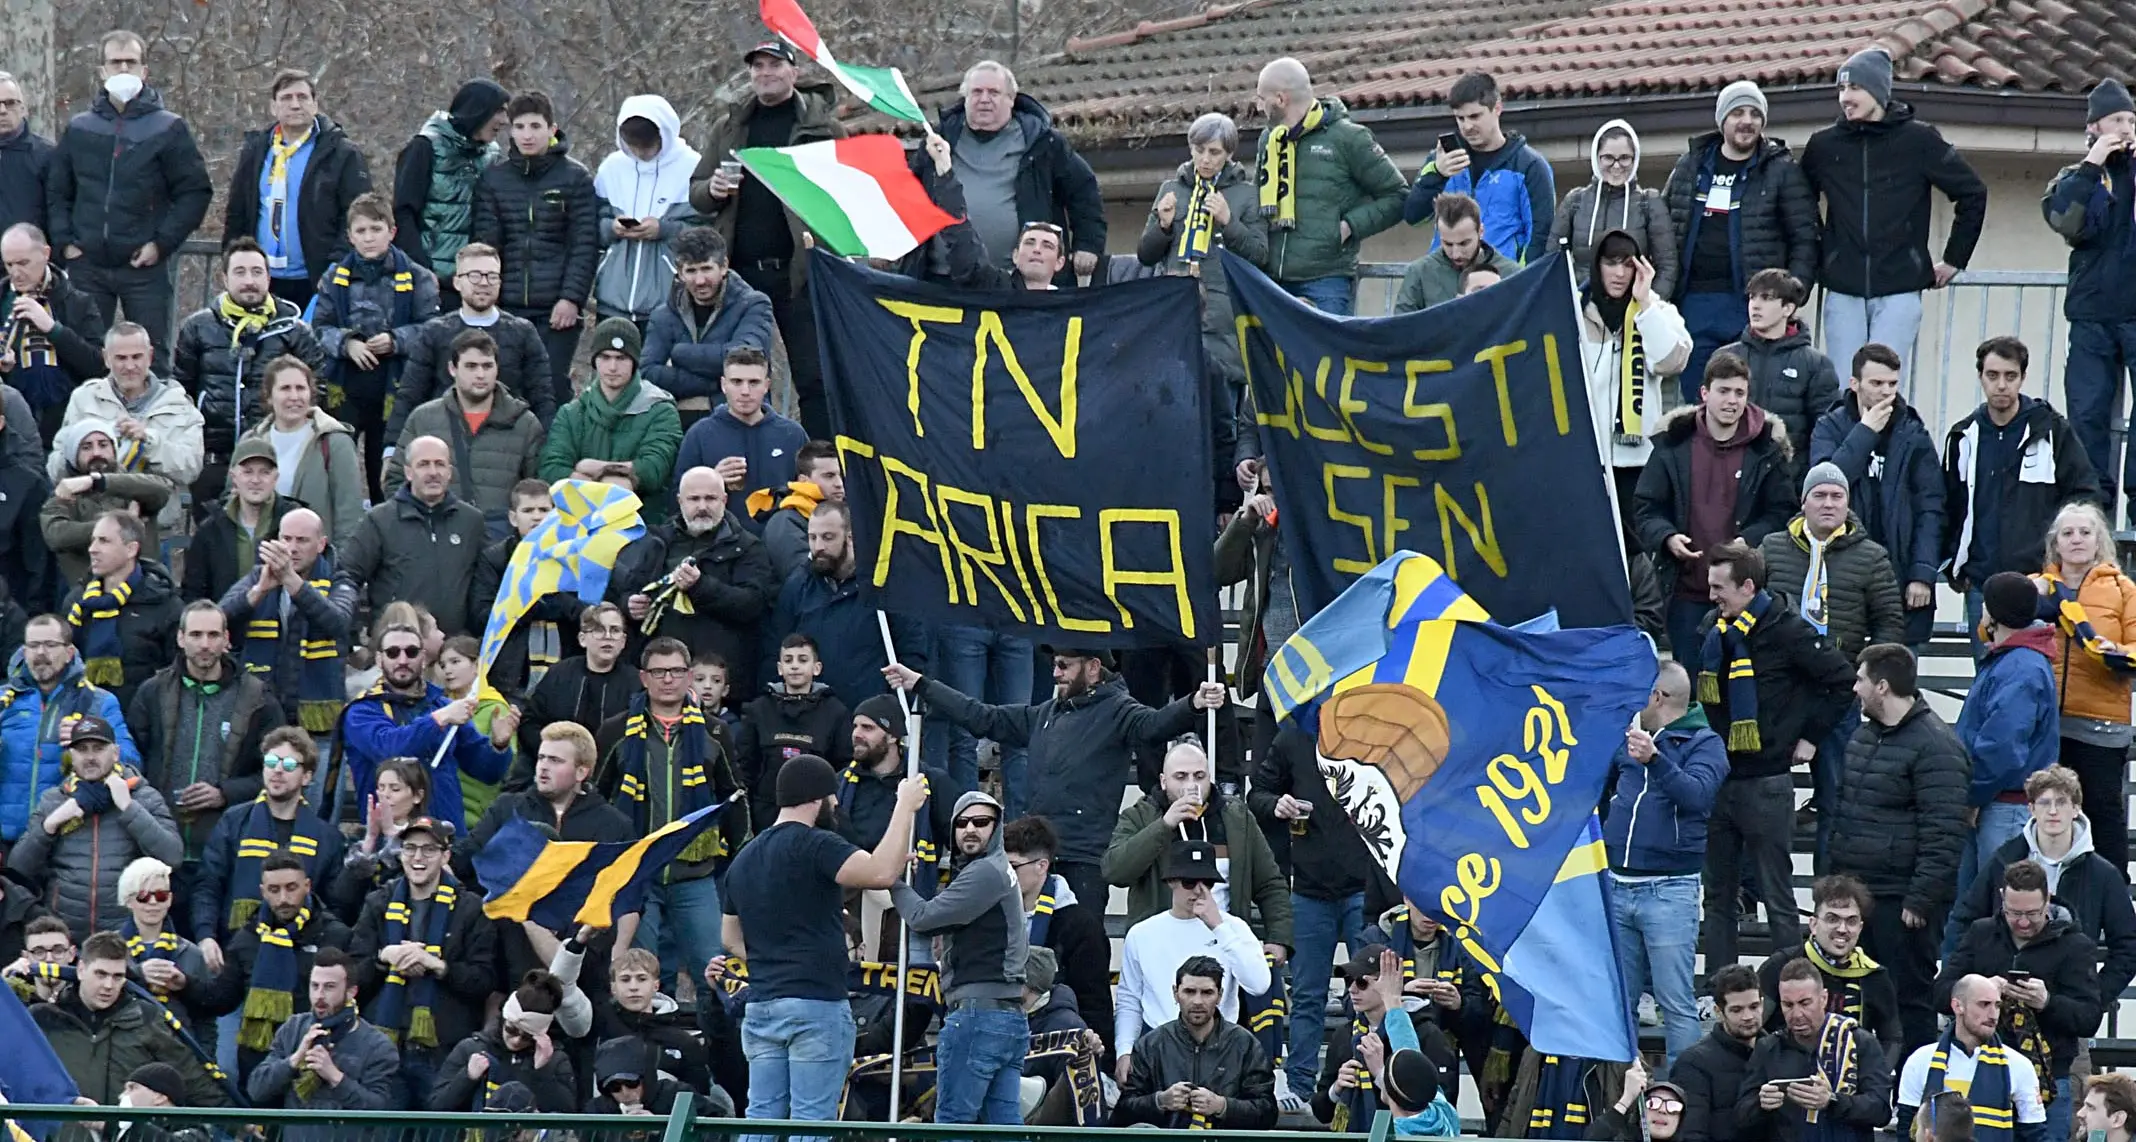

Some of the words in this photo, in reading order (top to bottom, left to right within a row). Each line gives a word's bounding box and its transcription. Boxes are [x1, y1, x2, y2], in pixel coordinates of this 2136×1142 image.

[875, 297, 1082, 459] TN
[1235, 314, 1571, 461] QUESTI
[1475, 684, 1579, 849] 1921
